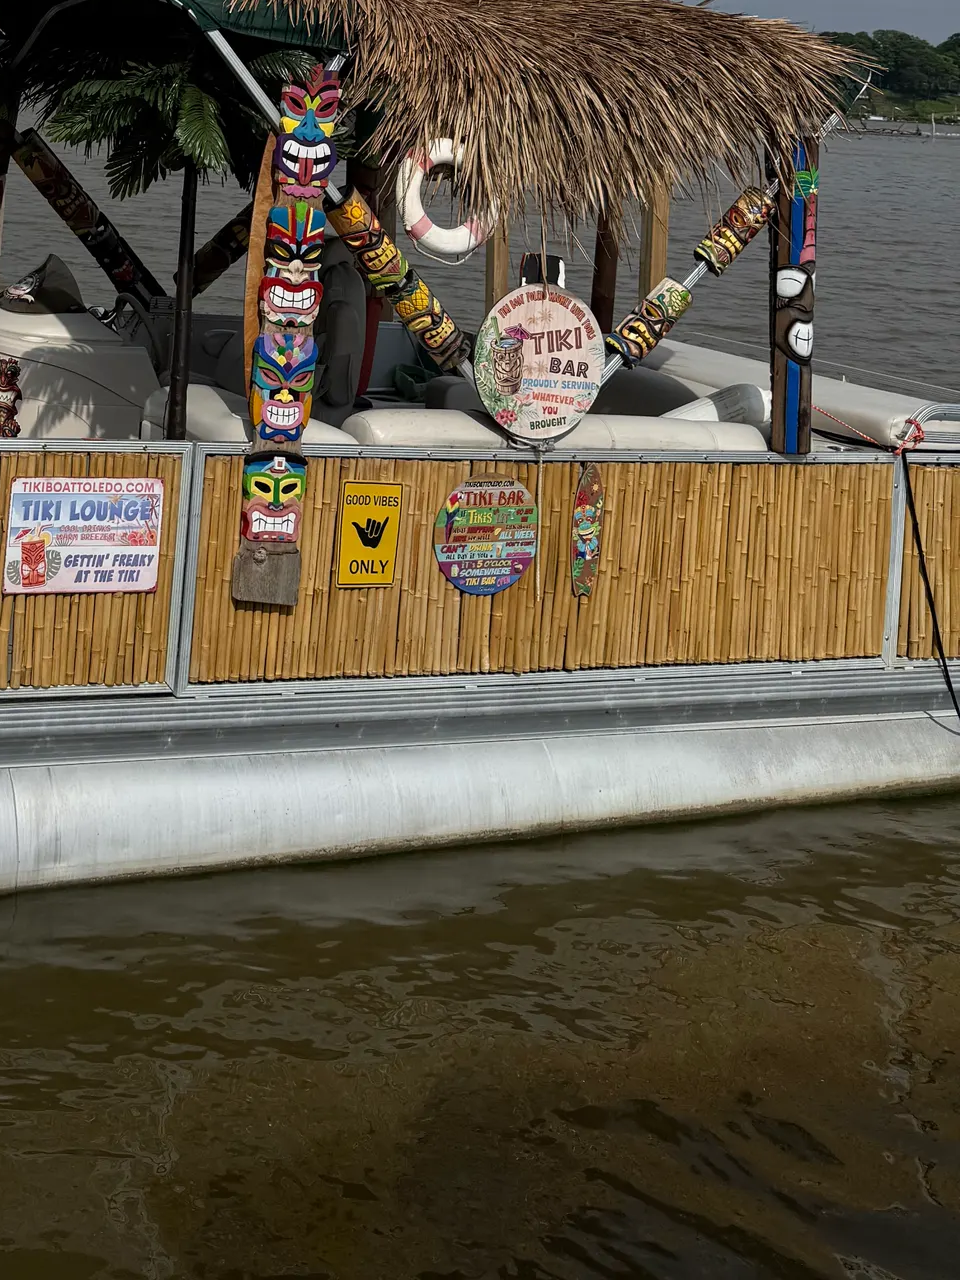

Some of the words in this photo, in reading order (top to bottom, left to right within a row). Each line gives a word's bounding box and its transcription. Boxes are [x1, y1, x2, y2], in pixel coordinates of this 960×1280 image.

[529, 326, 583, 356] TIKI
[549, 356, 589, 379] BAR
[522, 377, 559, 389] PROUDLY
[532, 391, 575, 406] WHATEVER
[541, 405, 559, 415] YOU
[529, 416, 567, 431] BROUGHT
[22, 481, 155, 493] TIKIBOATTOLEDO.COM
[345, 494, 371, 506] GOOD
[373, 495, 400, 507] VIBES
[464, 490, 494, 507] TIKI
[497, 490, 525, 506] BAR
[21, 500, 62, 521] TIKI
[69, 499, 152, 521] LOUNGE
[499, 531, 513, 540] ALL
[514, 531, 535, 539] WEEK
[440, 544, 468, 554] CAN'T
[468, 543, 494, 553] DRINK
[63, 553, 110, 569] GETTIN'
[111, 553, 155, 568] FREAKY
[349, 559, 389, 575] ONLY
[476, 560, 483, 568] 5
[74, 570, 90, 583] AT
[93, 570, 117, 583] THE
[118, 569, 141, 583] TIKI
[460, 567, 512, 577] SOMEWHERE
[465, 577, 480, 586] TIKI
[480, 576, 496, 586] BAR
